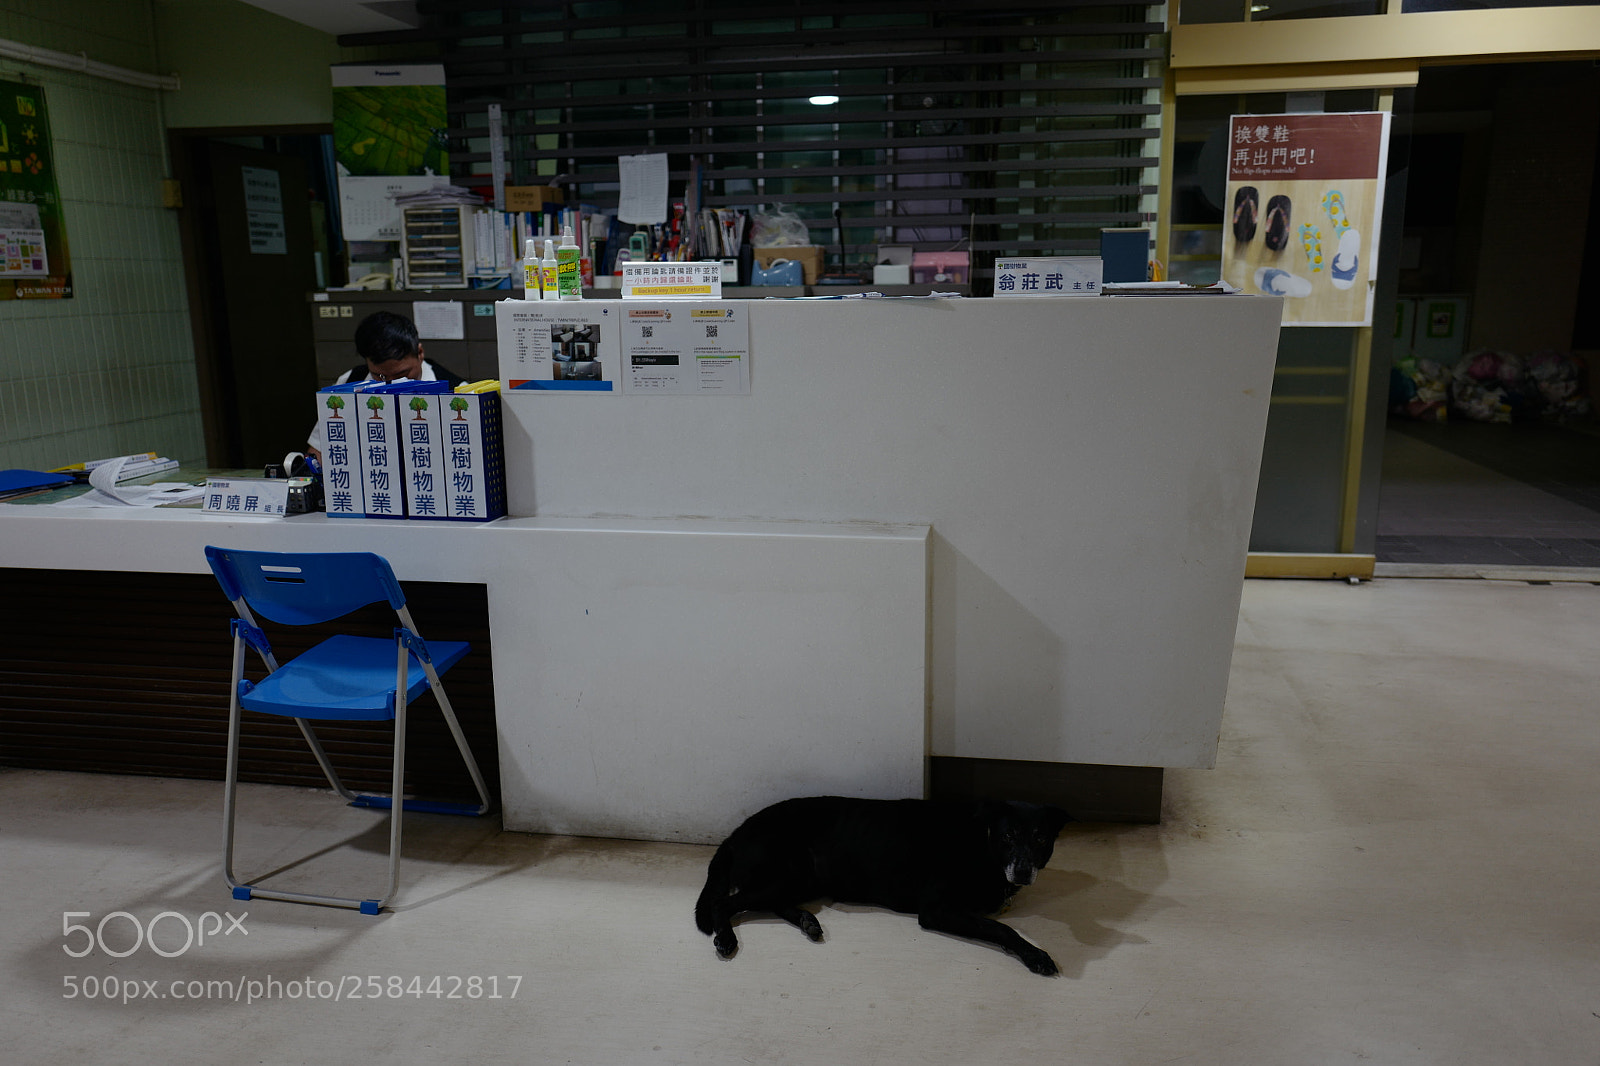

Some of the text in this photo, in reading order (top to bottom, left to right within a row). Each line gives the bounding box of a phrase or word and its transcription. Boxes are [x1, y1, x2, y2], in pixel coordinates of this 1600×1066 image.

[1234, 125, 1290, 143] 換雙鞋
[1232, 148, 1315, 166] 再出門吧!
[702, 275, 719, 283] 謝謝
[998, 273, 1095, 291] 翁莊武 主任
[637, 287, 658, 295] Backup
[327, 421, 353, 512] 國樹物業
[366, 422, 392, 513] 國樹物業
[409, 423, 436, 515] 國樹物業
[449, 423, 476, 516] 國樹物業
[208, 494, 259, 512] 周曉屏
